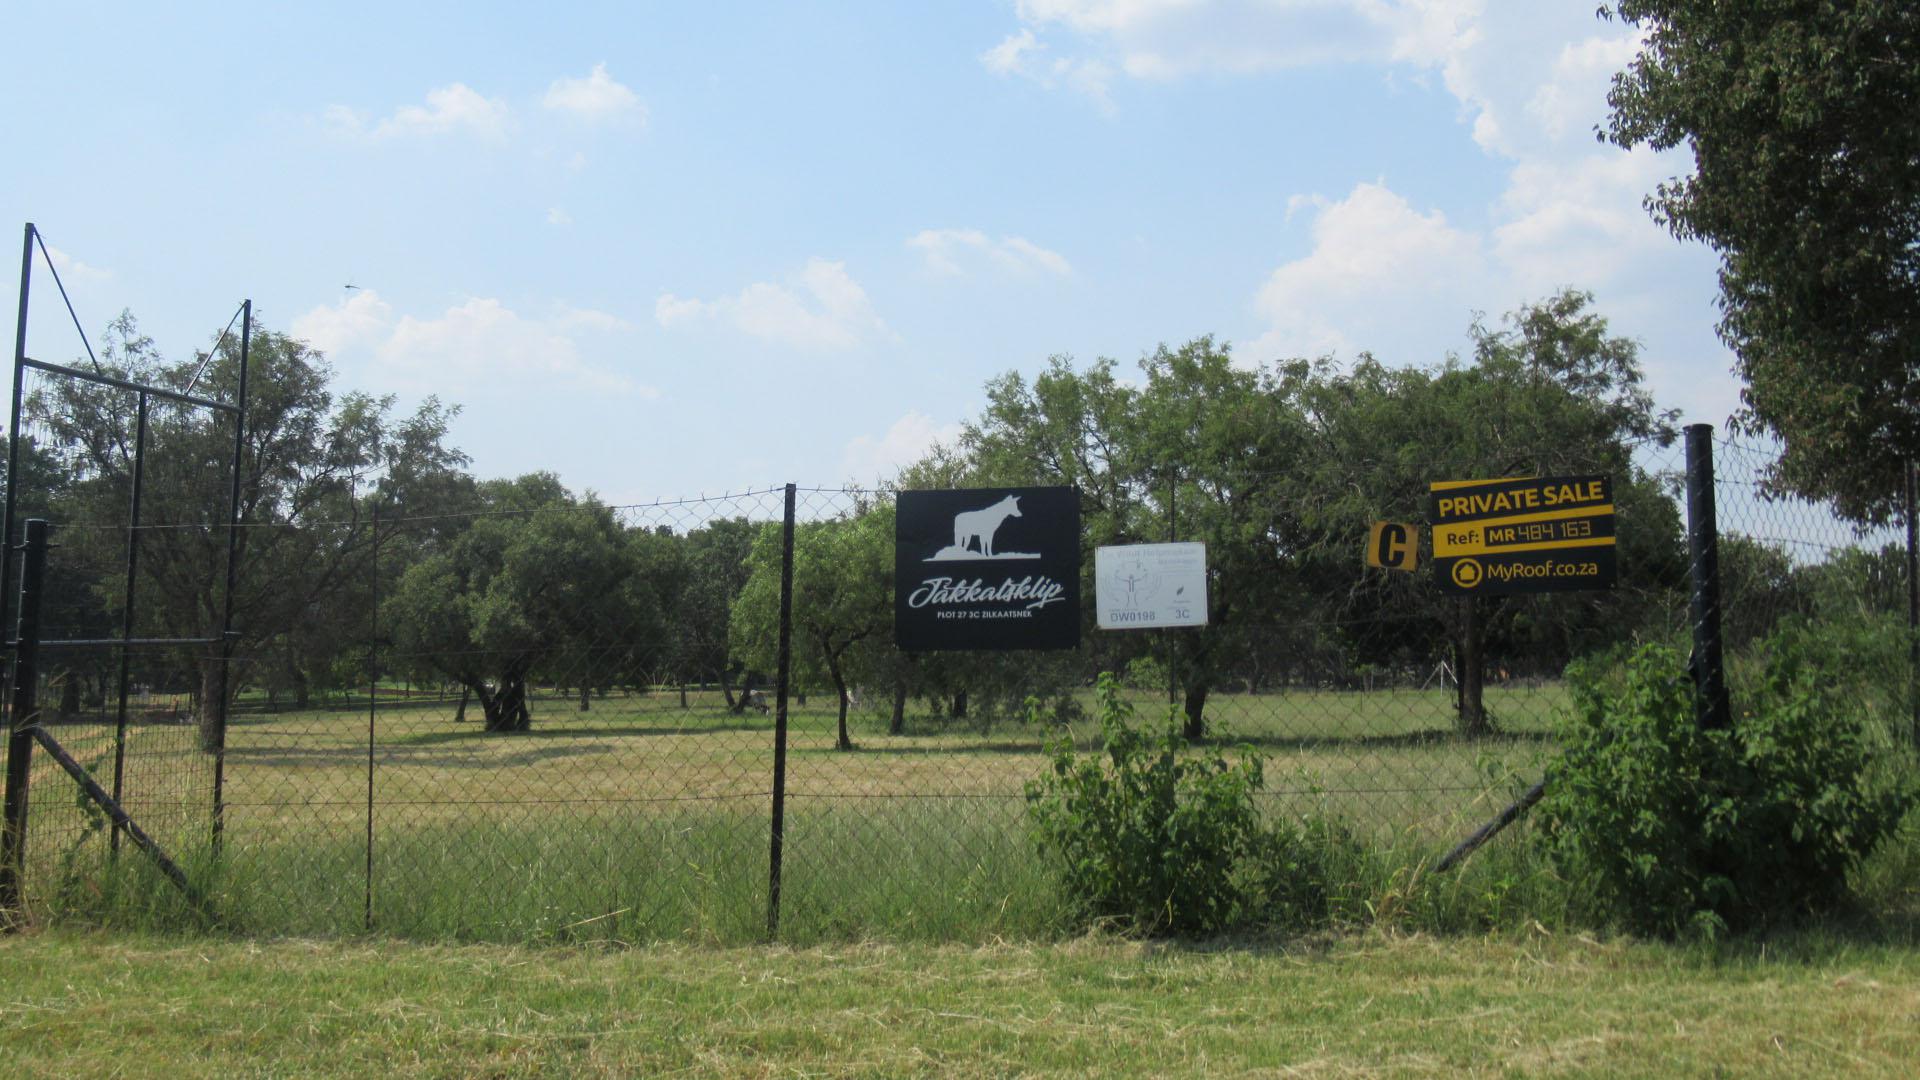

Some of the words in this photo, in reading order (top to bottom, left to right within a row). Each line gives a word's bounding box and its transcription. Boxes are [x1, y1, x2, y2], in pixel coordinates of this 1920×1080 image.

[1439, 488, 1540, 517] PRIVATE
[1543, 481, 1604, 505] SALE
[1378, 523, 1407, 568] C
[1447, 532, 1480, 546] Ref:
[1489, 529, 1516, 543] MR
[1518, 523, 1554, 541] 484
[1560, 520, 1591, 537] 163
[1487, 560, 1598, 582] MyRoof.co.za
[909, 576, 1065, 608] Jakkalsklip
[937, 611, 956, 619] PLOT
[957, 611, 967, 619] 27
[1175, 609, 1190, 619] 3C
